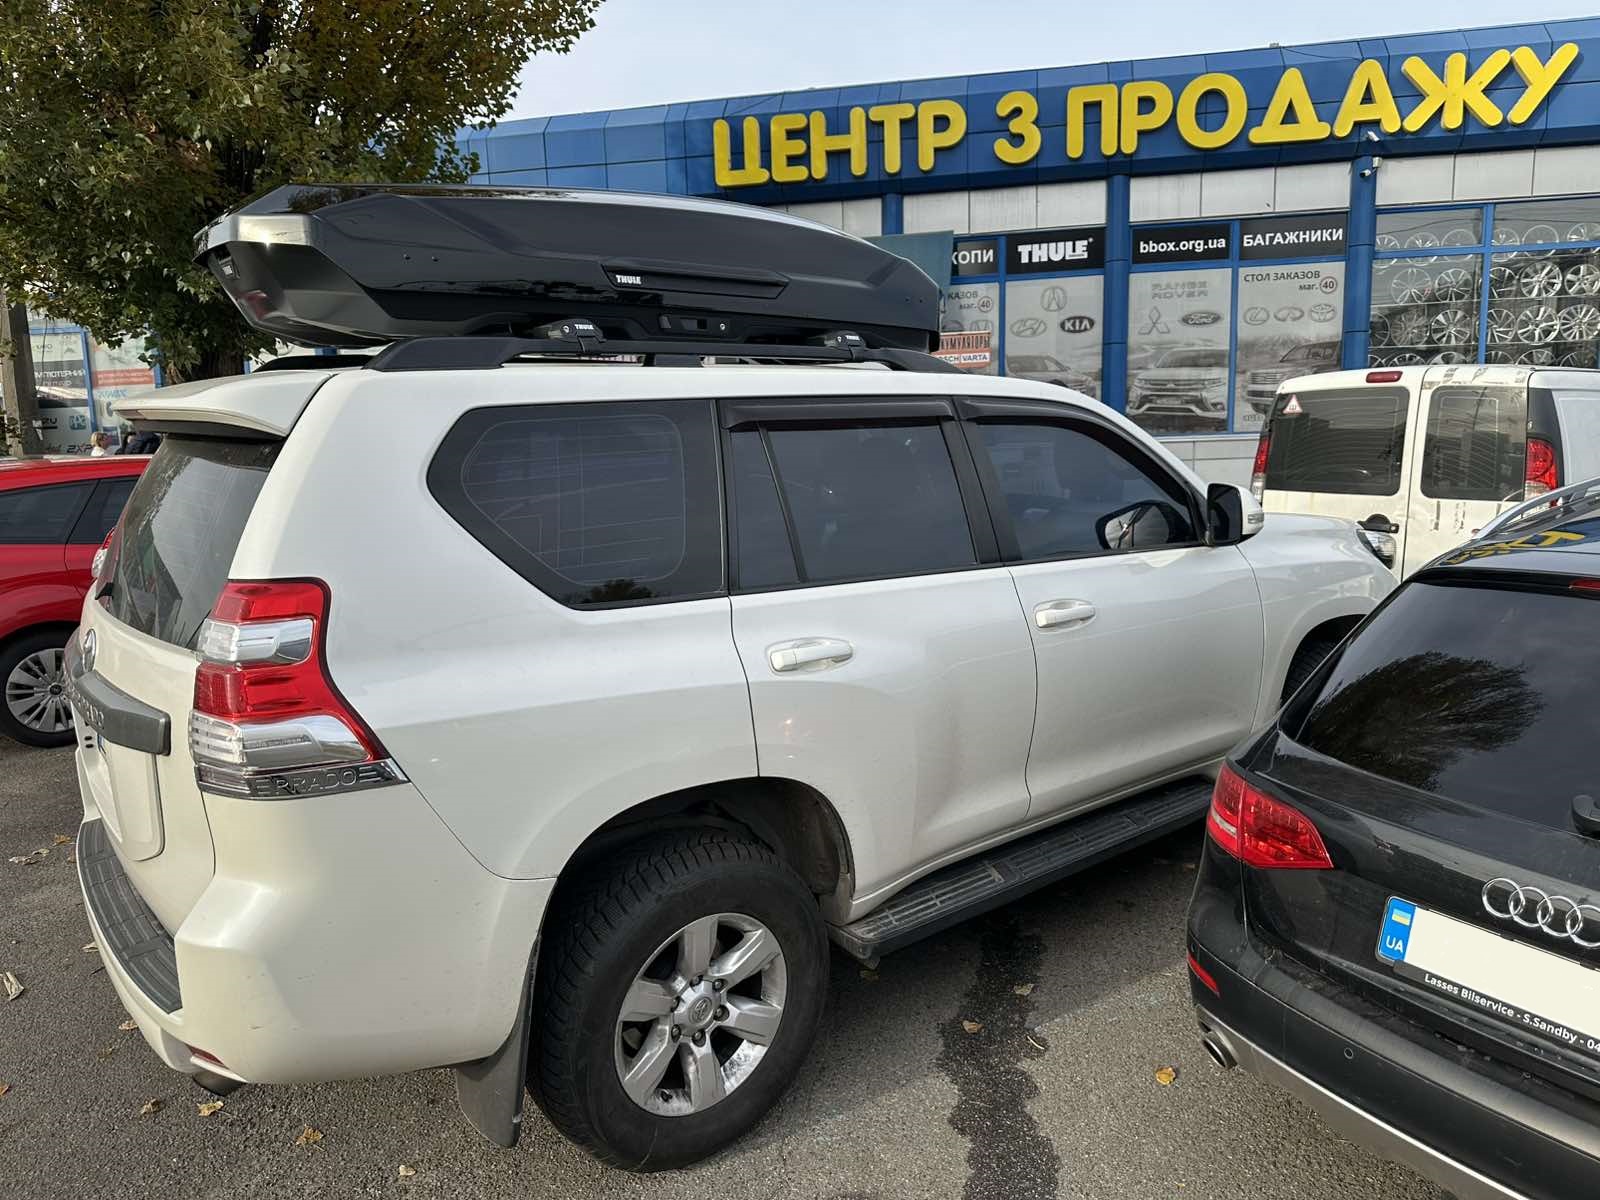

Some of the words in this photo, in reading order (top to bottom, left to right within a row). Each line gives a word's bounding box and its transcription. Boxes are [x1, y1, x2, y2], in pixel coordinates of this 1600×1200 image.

[713, 100, 967, 186] ЦЕНТР
[1066, 43, 1579, 158] ПРОДАЖУ
[1243, 228, 1343, 247] БАГАЖНИКИ
[1139, 238, 1226, 253] bbox.org.ua
[616, 274, 642, 285] THULE
[1243, 273, 1271, 282] СТОЛ
[1273, 271, 1321, 281] ЗАКАЗОВ
[1322, 280, 1335, 289] 40
[980, 300, 991, 308] 40
[1064, 318, 1091, 331] KIA
[962, 353, 988, 362] VARTA
[1386, 935, 1404, 953] UA
[1424, 973, 1459, 995] Lasses
[1461, 987, 1514, 1018] Bilservice
[1523, 1013, 1578, 1044] S.Sandby
